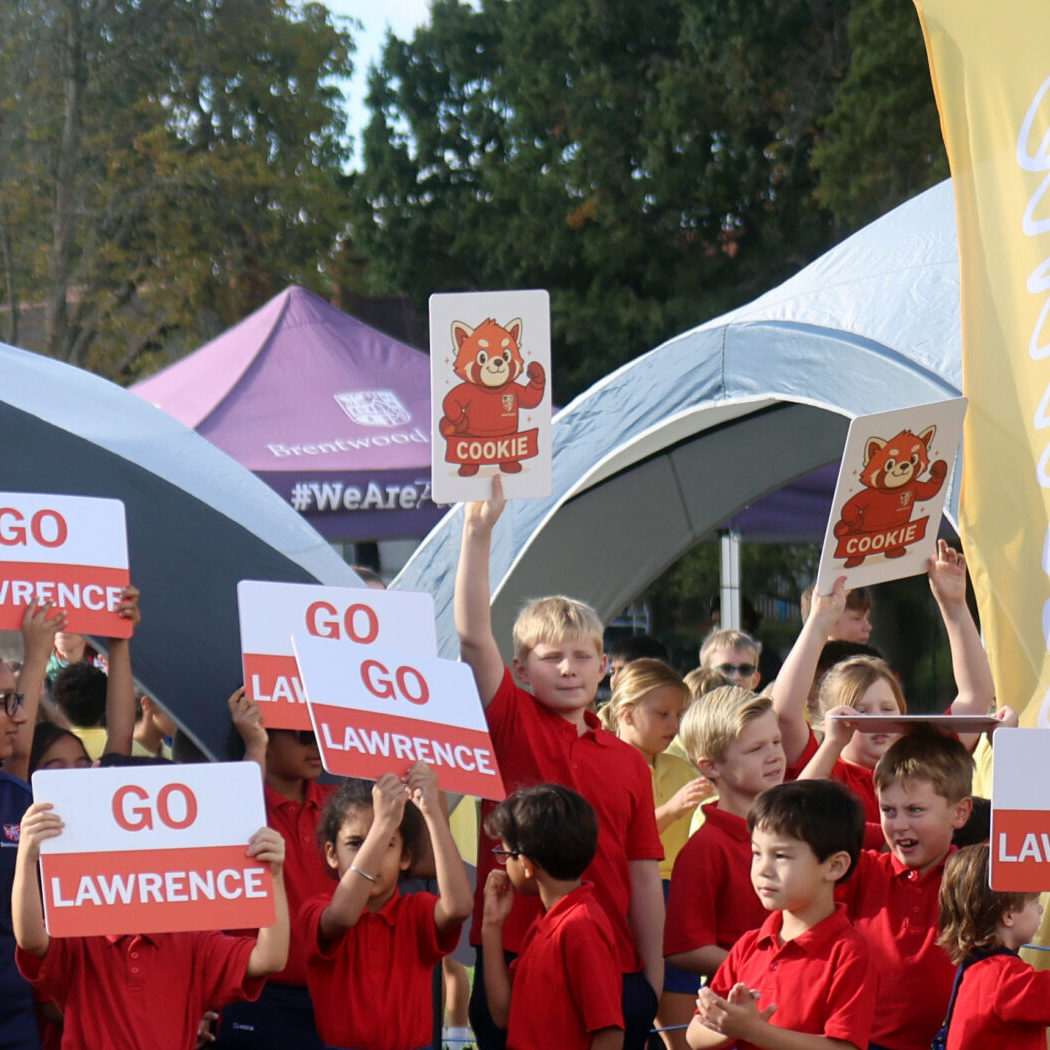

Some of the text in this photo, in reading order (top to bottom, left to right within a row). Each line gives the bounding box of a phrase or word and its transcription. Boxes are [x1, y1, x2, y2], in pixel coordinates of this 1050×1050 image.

[265, 428, 430, 458] Brentwood
[456, 436, 529, 460] COOKIE
[846, 524, 917, 554] COOKIE
[305, 600, 380, 645] GO
[360, 659, 430, 706] GO
[320, 723, 497, 776] LAWRENCE
[111, 782, 198, 832] GO
[51, 867, 268, 908] LAWRENCE
